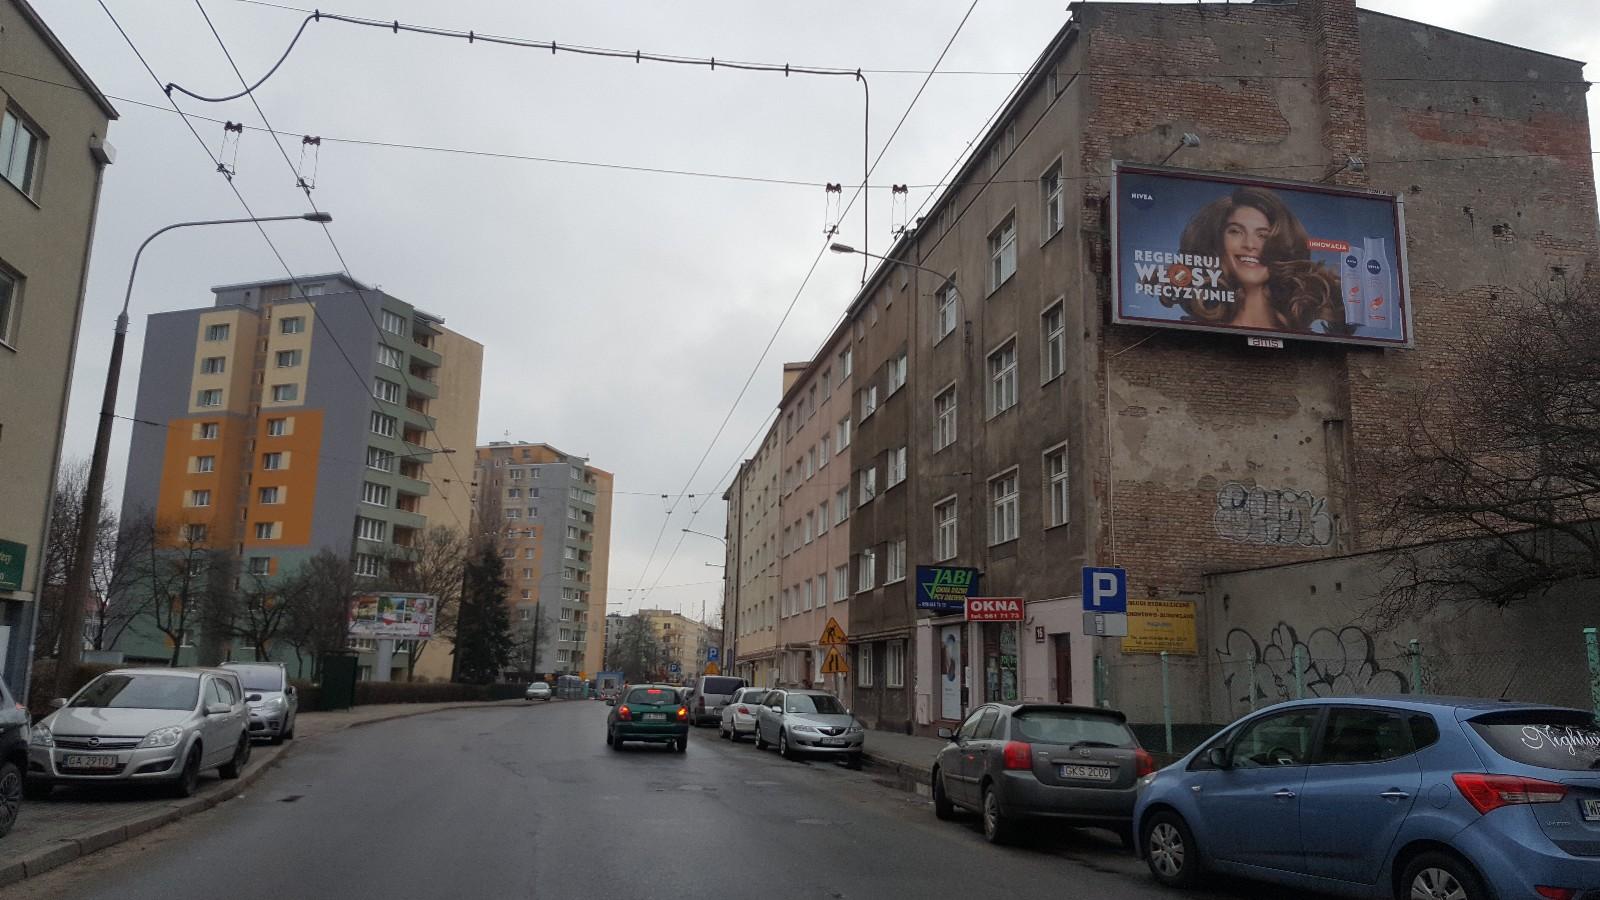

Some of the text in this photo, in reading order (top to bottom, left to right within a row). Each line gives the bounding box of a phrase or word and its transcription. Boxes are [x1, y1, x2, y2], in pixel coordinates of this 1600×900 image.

[1131, 193, 1153, 201] NIVEA
[1134, 250, 1220, 268] REGENERUJ
[1135, 284, 1236, 303] PRECYZYJNIE
[1092, 571, 1118, 606] P
[970, 600, 1020, 611] OKNA
[709, 648, 717, 659] P
[1065, 766, 1086, 776] GKS
